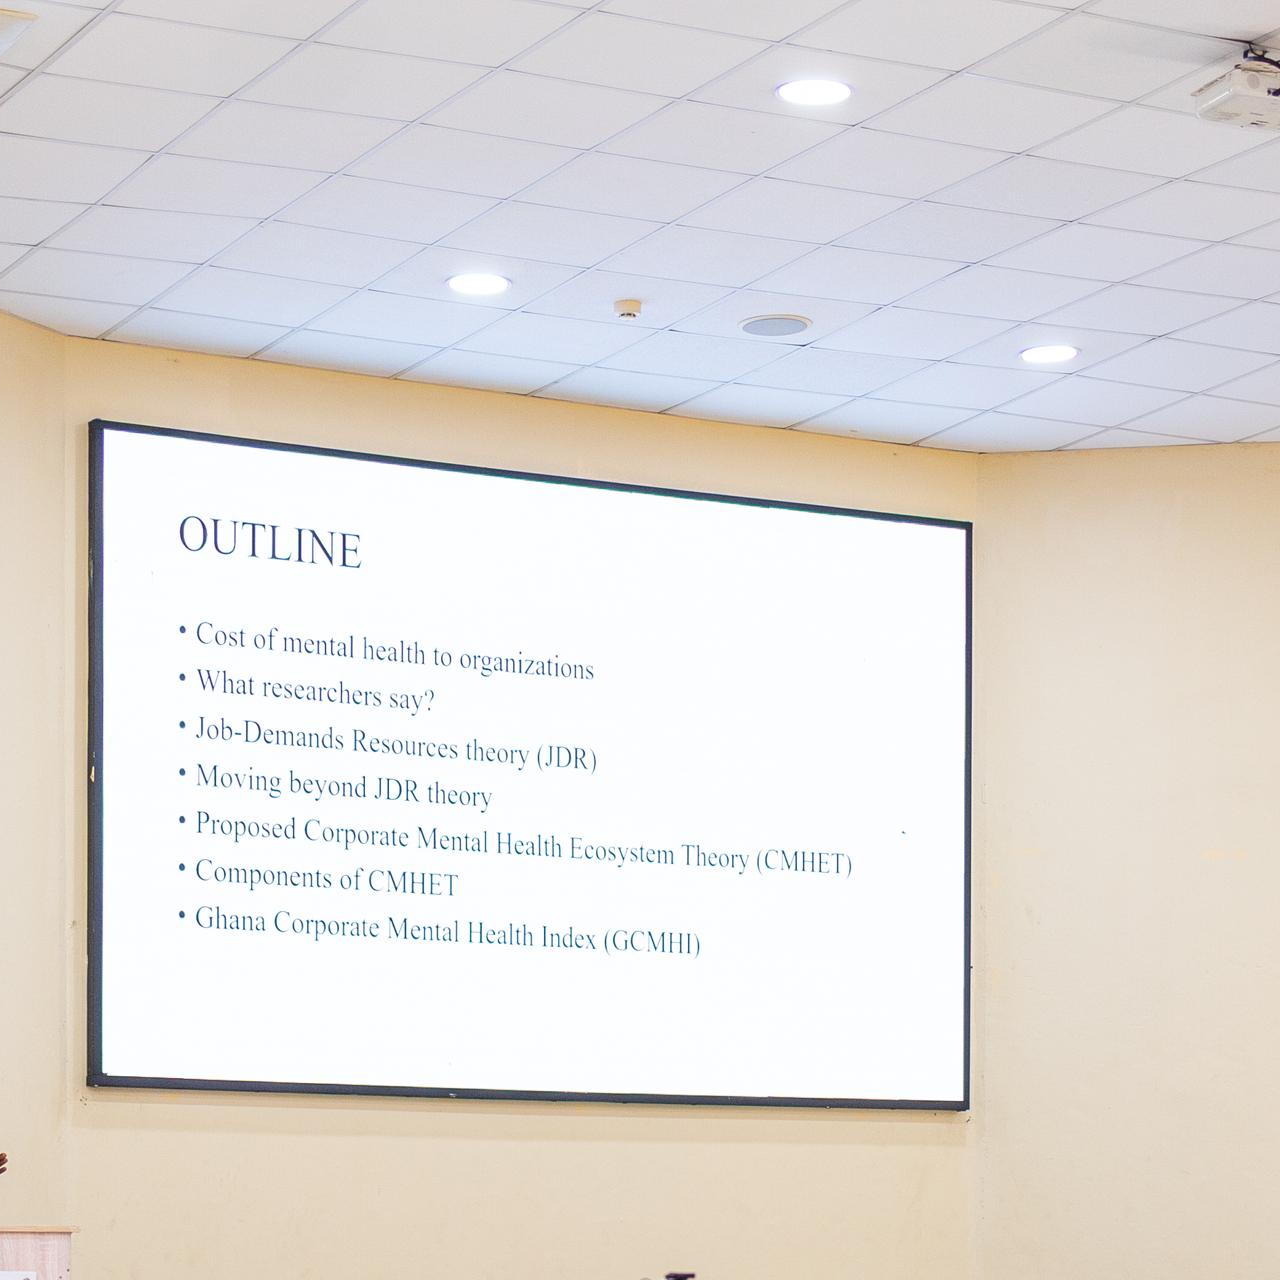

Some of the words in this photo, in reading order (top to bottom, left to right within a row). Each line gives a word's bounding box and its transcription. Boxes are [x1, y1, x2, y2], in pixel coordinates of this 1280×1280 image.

[180, 516, 361, 568] OUTLINE
[197, 622, 245, 647] Cost
[254, 628, 278, 650] of
[284, 636, 353, 658] mental
[364, 637, 424, 664] health
[434, 649, 451, 666] to
[460, 651, 593, 679] organizations
[198, 669, 253, 695] What
[264, 681, 381, 706] researchers
[390, 690, 434, 716] say?
[196, 717, 343, 749] Job-Demands
[354, 730, 457, 758] Resources
[467, 739, 529, 771] theory
[538, 746, 596, 772] (JDR)
[197, 764, 281, 798] Moving
[290, 770, 366, 801] beyond
[375, 778, 419, 802] JDR
[428, 782, 492, 813] theory
[198, 811, 295, 842] Proposed
[305, 820, 408, 850] Corporate
[418, 827, 487, 852] Mental
[498, 832, 561, 857] Health
[571, 837, 673, 868] Ecosystem
[682, 845, 749, 874] Theory
[757, 850, 851, 876] (CMHET)
[196, 859, 331, 891] Components
[340, 868, 364, 890] of
[369, 870, 458, 895] CMHET
[196, 906, 265, 931] Ghana
[274, 911, 379, 941] Corporate
[389, 917, 458, 942] Mental
[469, 922, 533, 946] Health
[543, 926, 595, 949] Index
[605, 930, 699, 955] (GCMHI)
